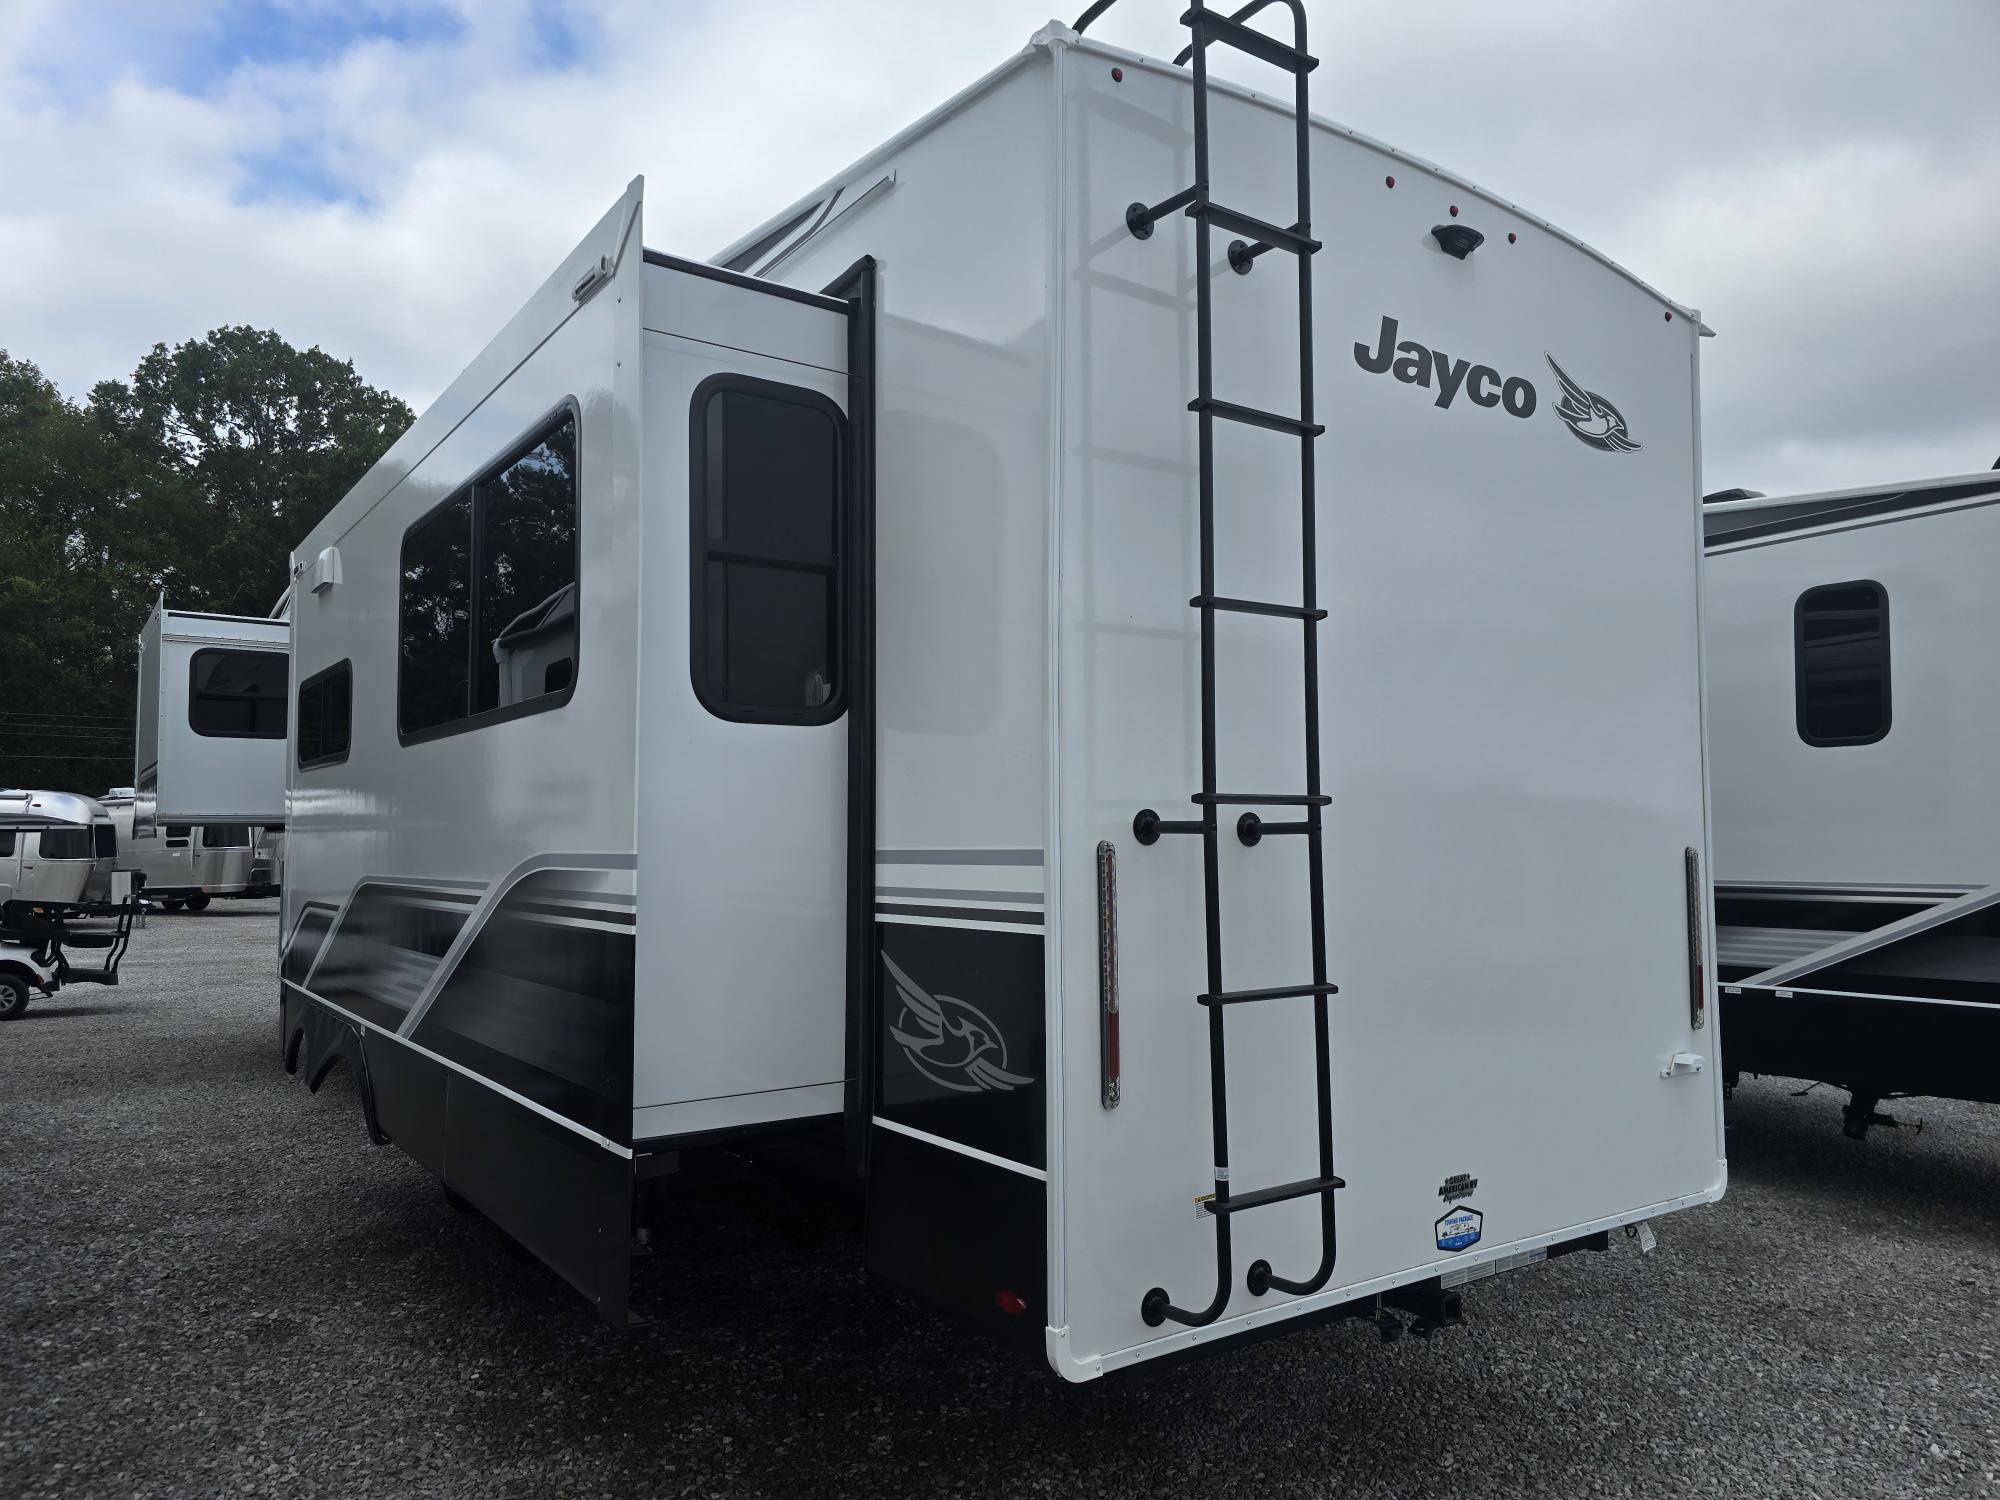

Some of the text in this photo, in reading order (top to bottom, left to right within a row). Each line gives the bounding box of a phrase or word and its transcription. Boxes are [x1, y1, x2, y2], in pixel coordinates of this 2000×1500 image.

[1353, 315, 1537, 419] Jayco
[1438, 1178, 1479, 1196] AMERICAN RV
[1449, 1173, 1467, 1185] GREAT
